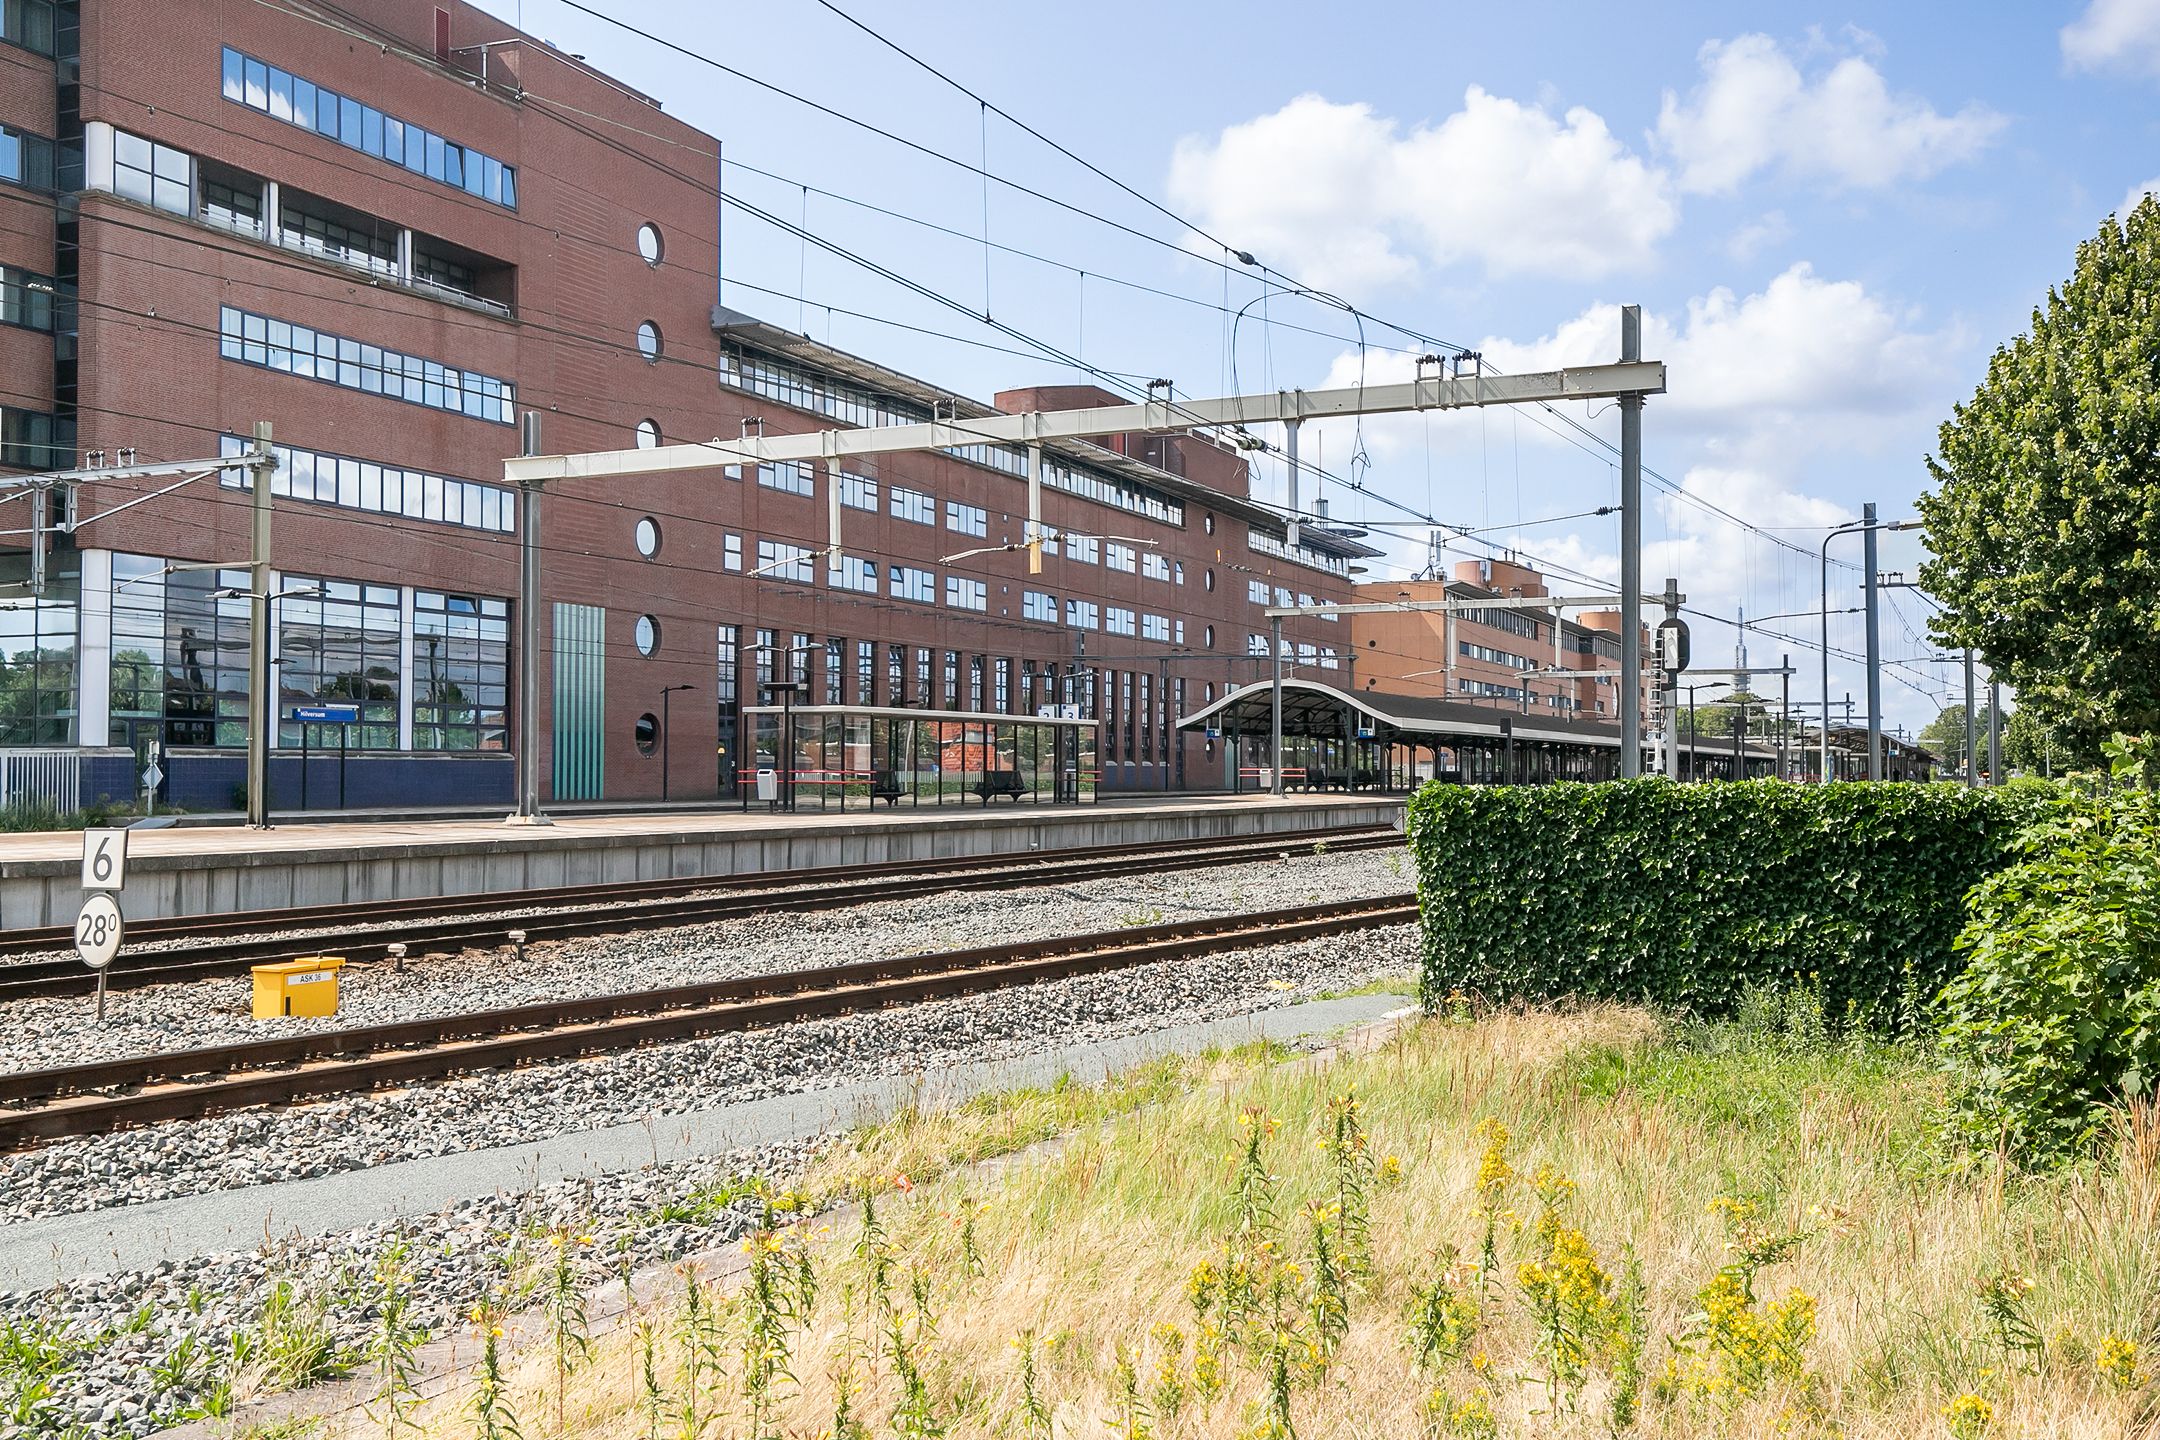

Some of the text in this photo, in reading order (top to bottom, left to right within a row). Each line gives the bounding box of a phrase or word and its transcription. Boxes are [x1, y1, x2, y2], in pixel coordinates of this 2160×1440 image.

[300, 710, 326, 718] Hilversum
[92, 837, 113, 882] 6
[299, 974, 313, 983] ASK
